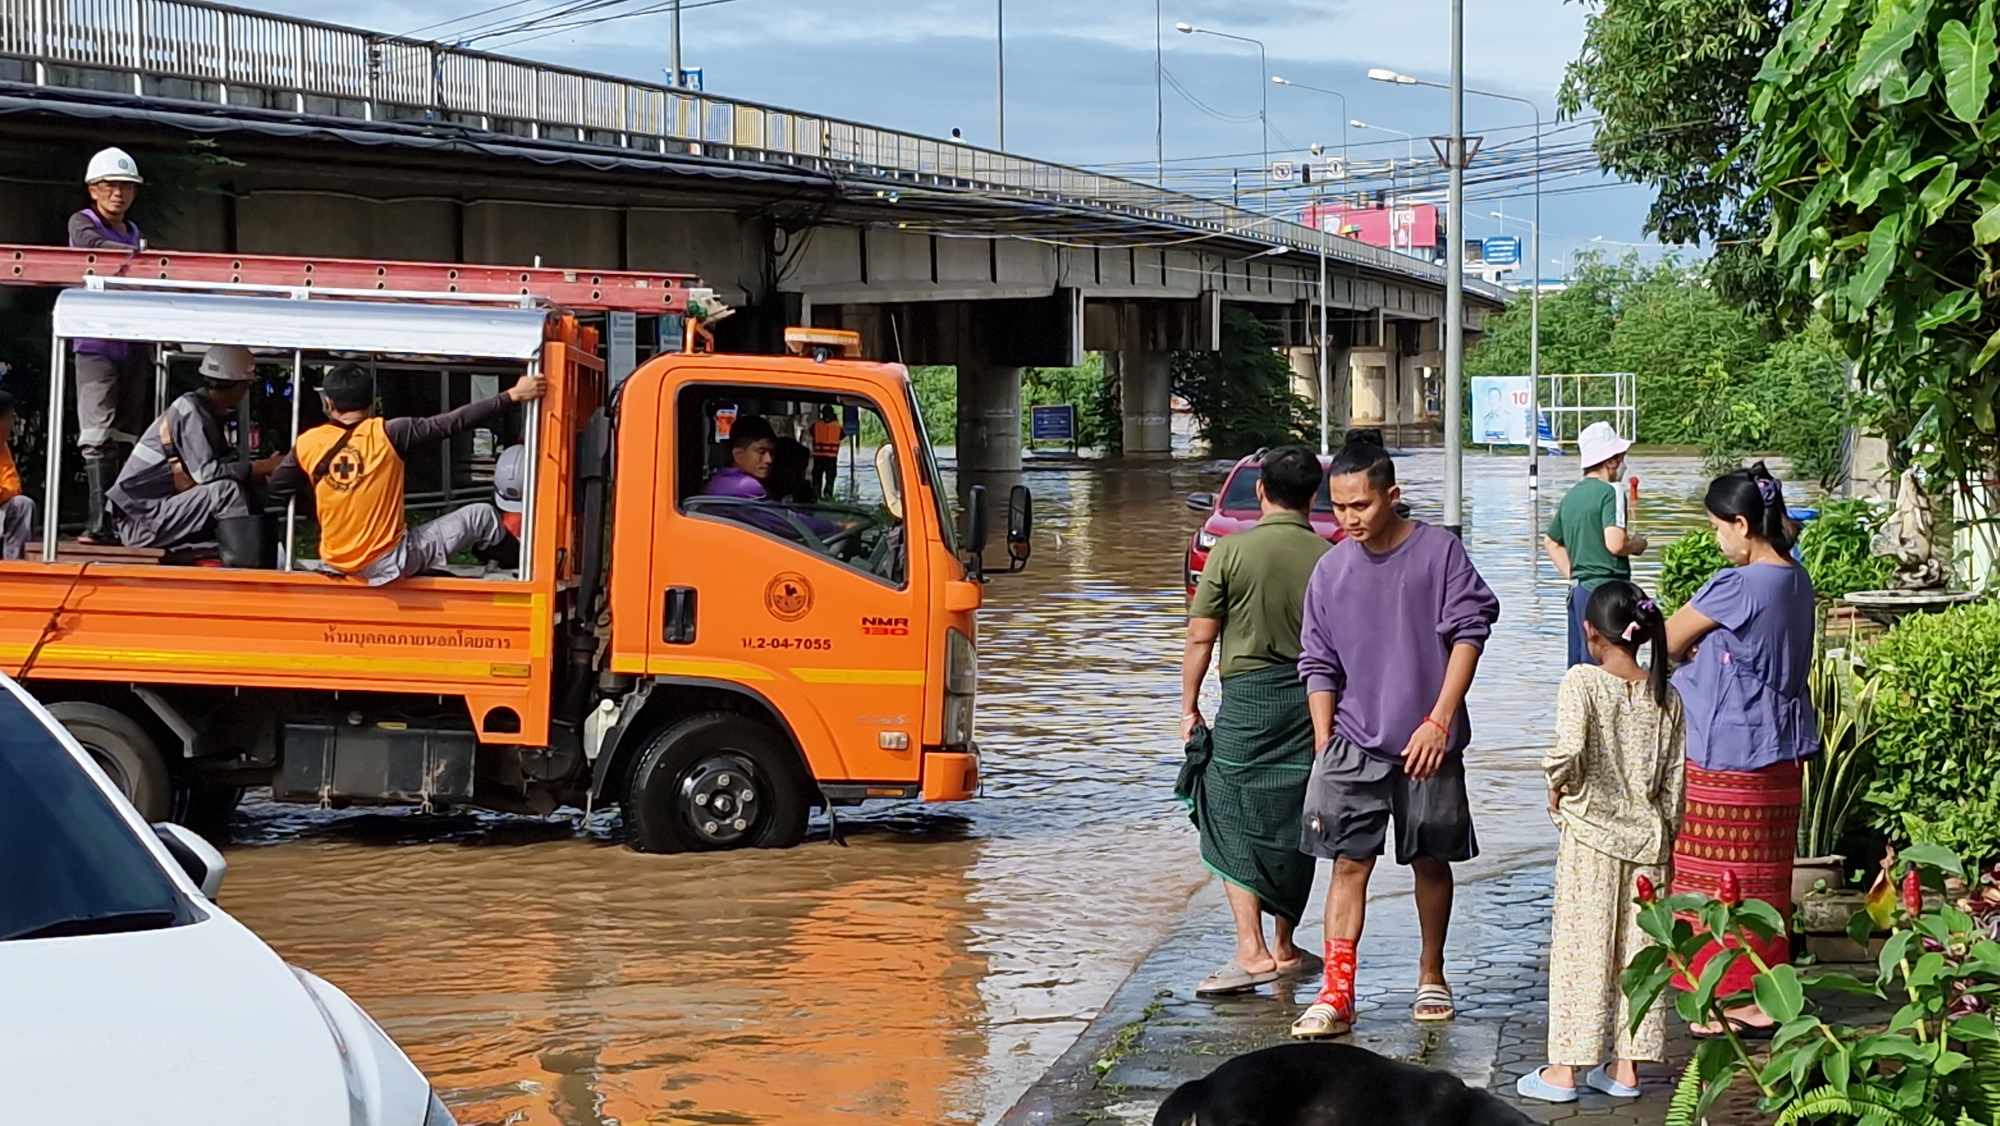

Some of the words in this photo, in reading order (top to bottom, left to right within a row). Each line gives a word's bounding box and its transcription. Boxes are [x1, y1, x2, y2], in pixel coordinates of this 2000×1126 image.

[862, 617, 909, 627] NMR
[862, 627, 909, 636] 130
[323, 625, 511, 649] ห้ามบุคคลภายนอกโดยสาร
